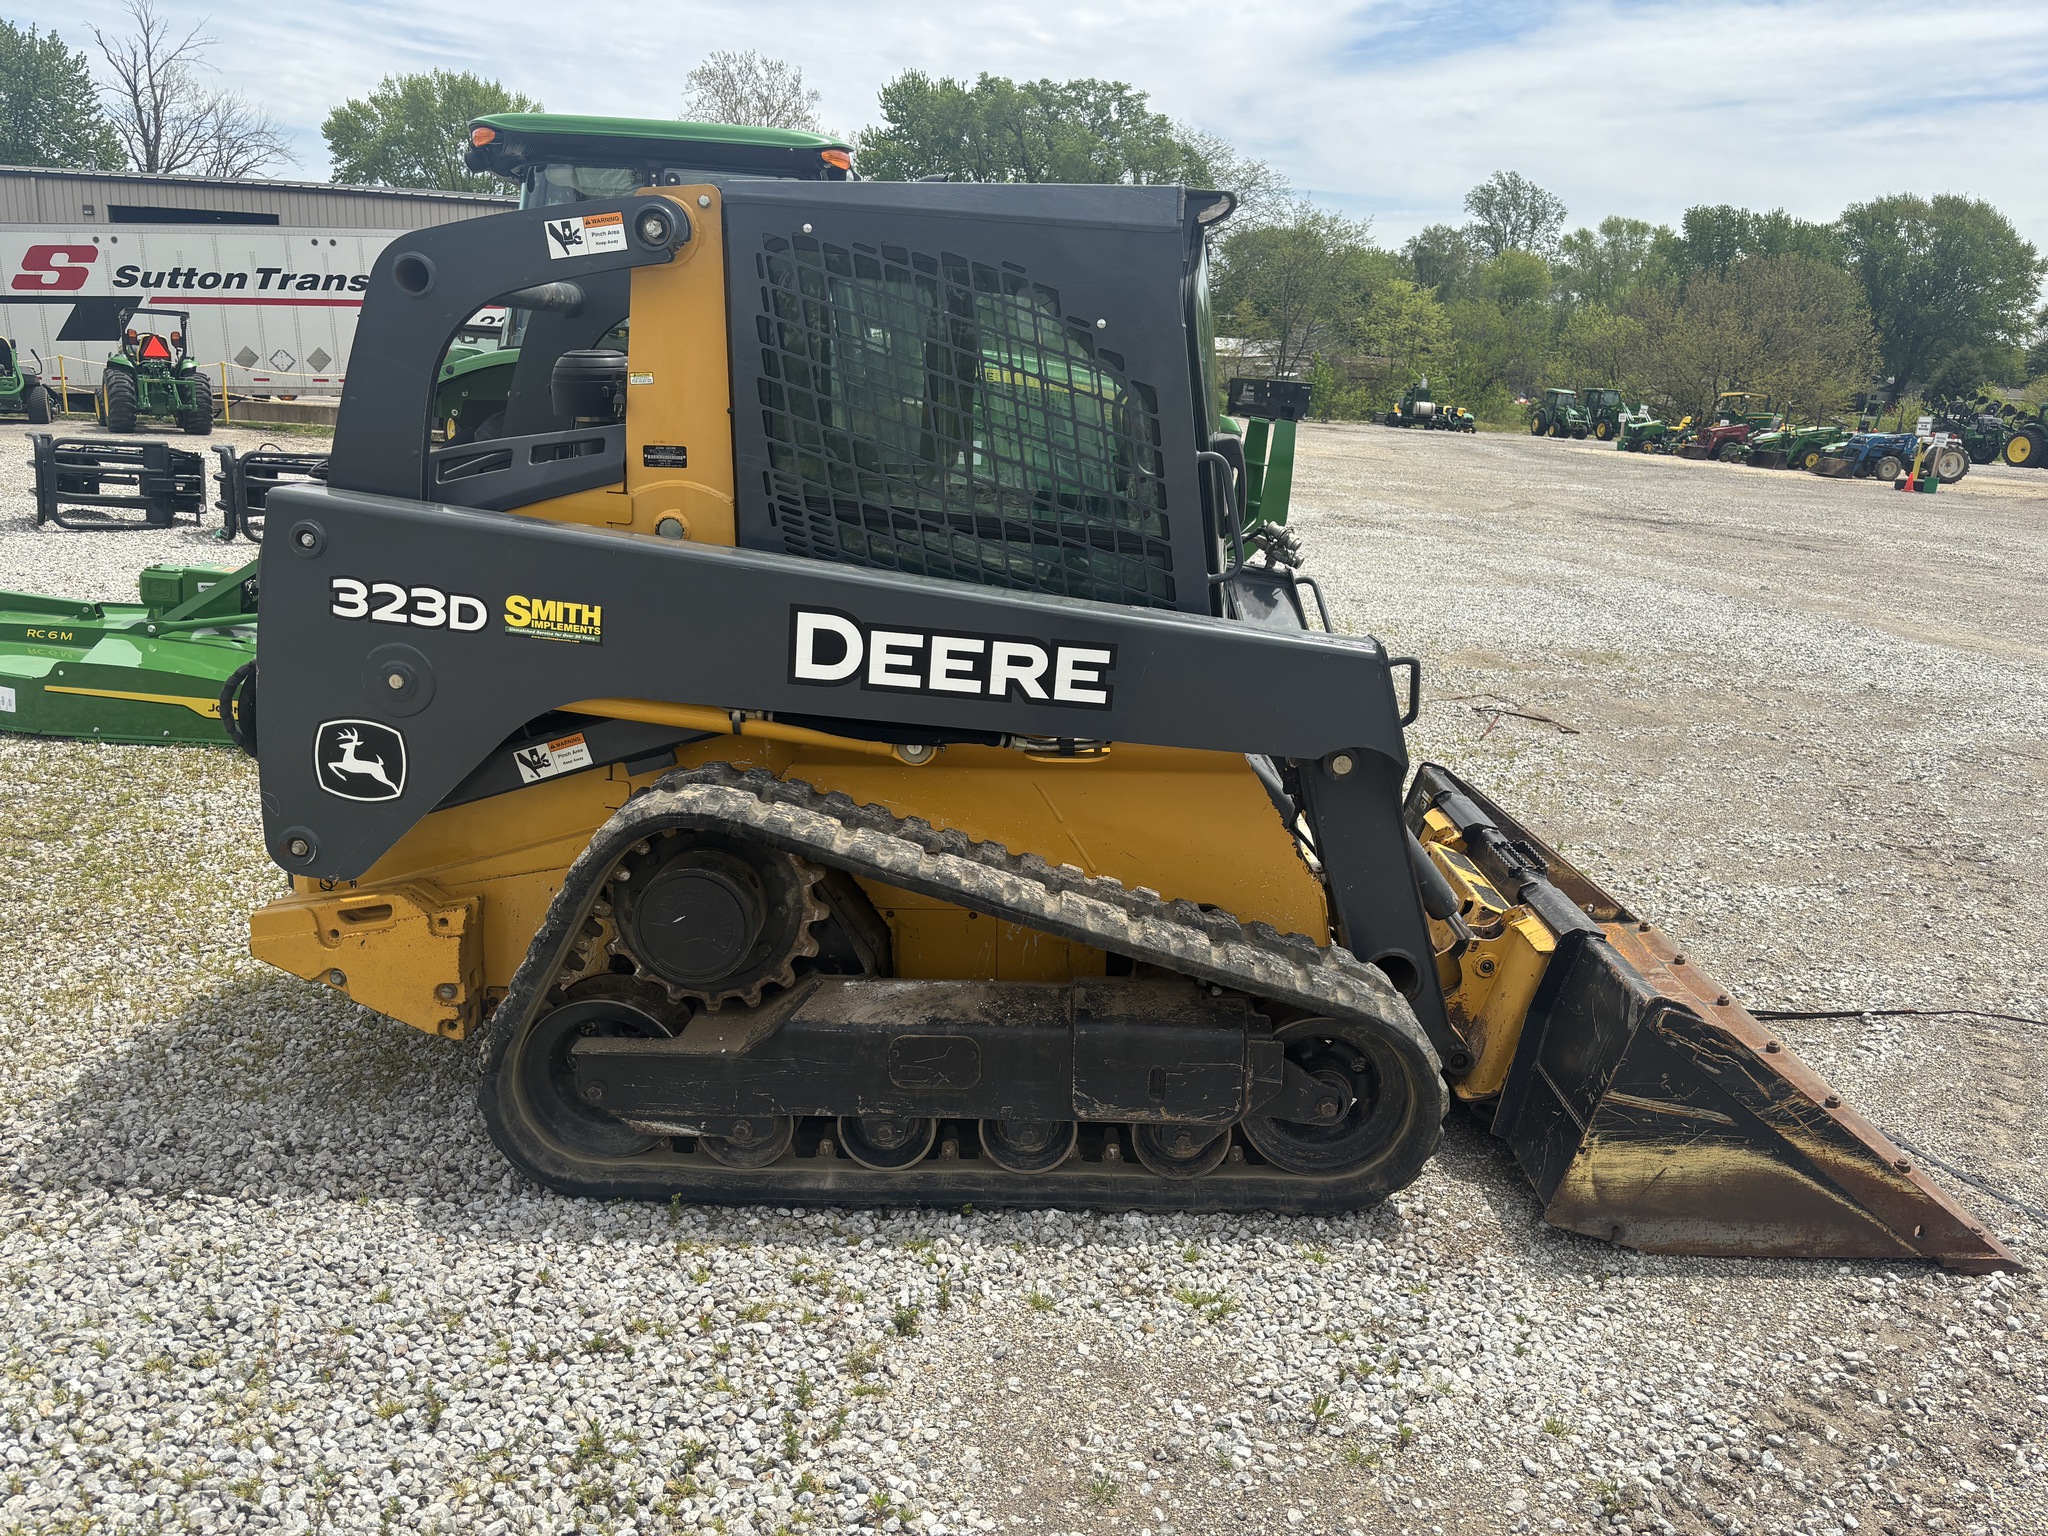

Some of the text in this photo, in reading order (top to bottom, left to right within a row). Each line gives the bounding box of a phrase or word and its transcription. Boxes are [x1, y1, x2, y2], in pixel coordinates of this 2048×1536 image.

[591, 216, 620, 224] WARNING
[112, 264, 248, 290] Sutton
[332, 578, 488, 632] 323D
[504, 595, 601, 626] SMITH
[532, 620, 601, 634] IMPLEMENTS
[794, 611, 1111, 704] DEERE
[556, 736, 581, 747] WARNING
